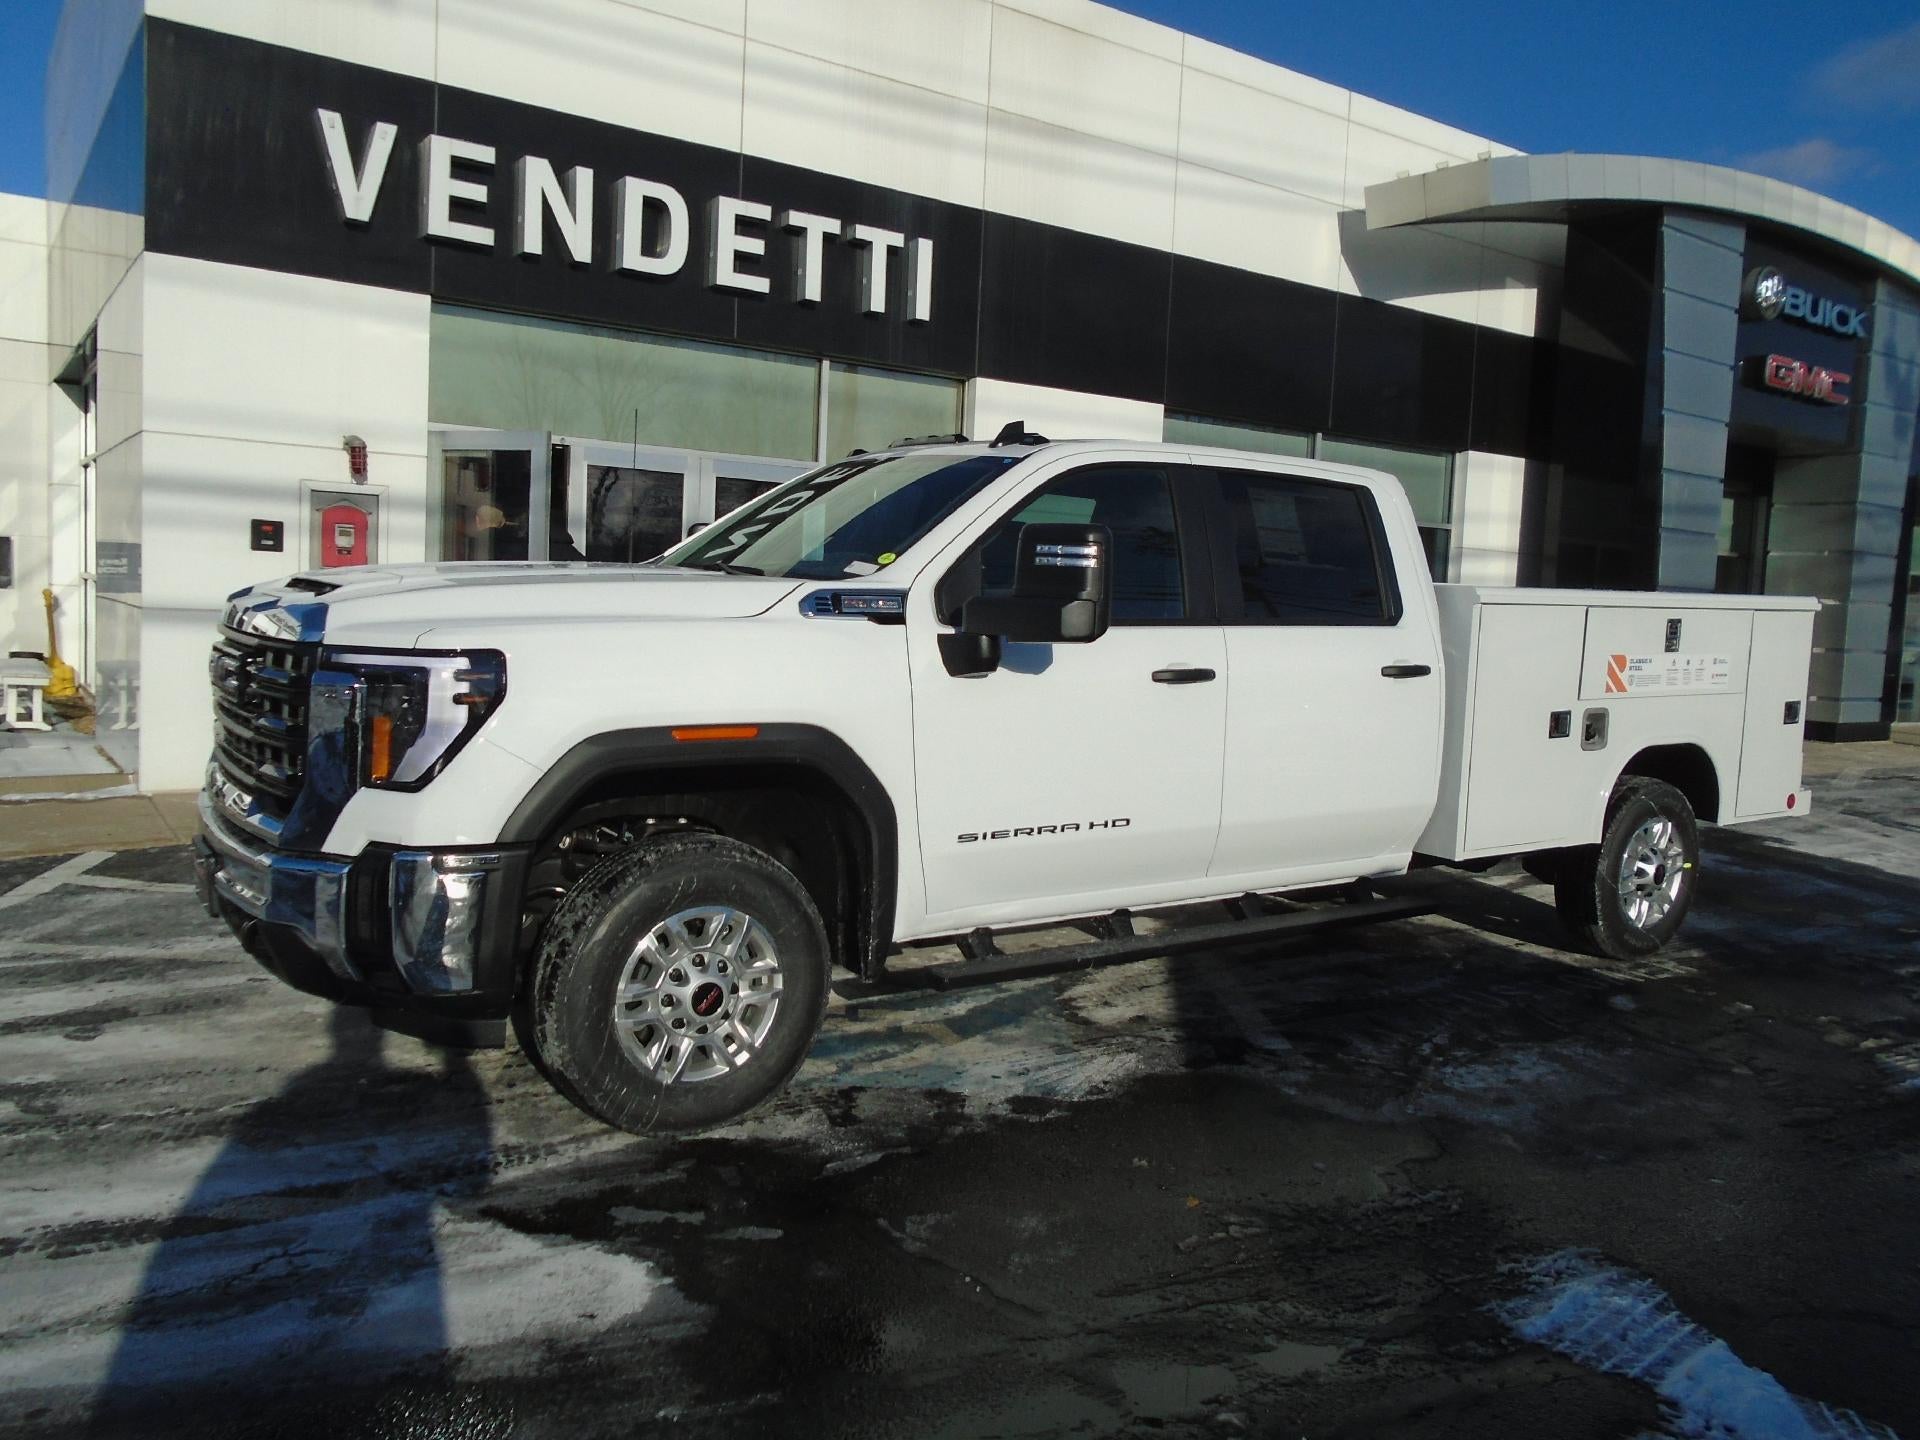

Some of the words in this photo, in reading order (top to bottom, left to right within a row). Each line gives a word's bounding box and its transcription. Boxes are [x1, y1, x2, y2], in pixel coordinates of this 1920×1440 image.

[316, 108, 933, 321] VENDETTI
[1784, 285, 1869, 338] BUICK
[1765, 353, 1851, 405] GMC
[957, 822, 1080, 843] SIERRA
[1088, 817, 1131, 830] HD
